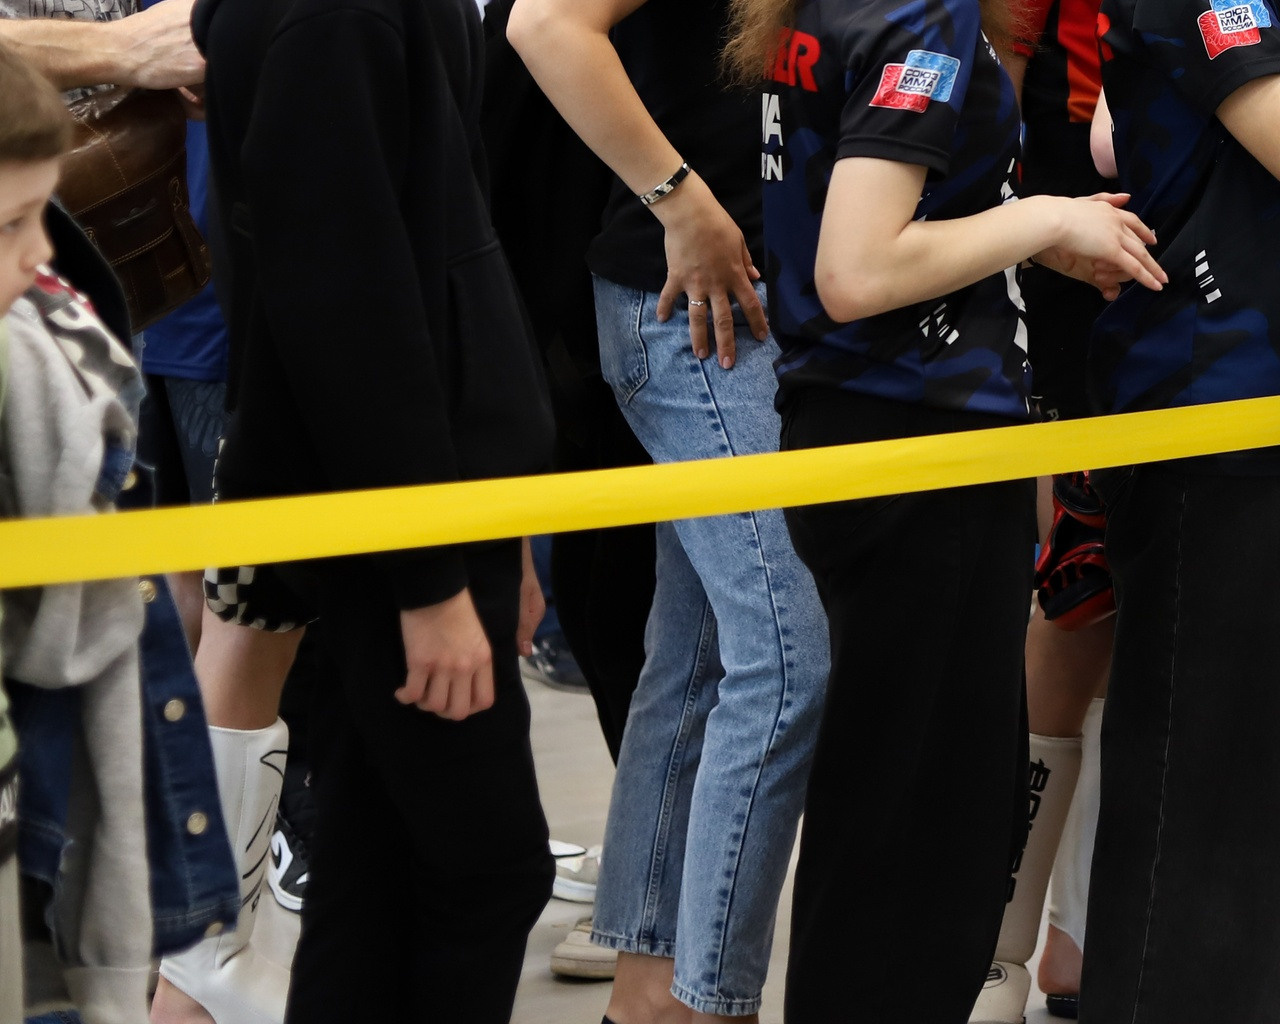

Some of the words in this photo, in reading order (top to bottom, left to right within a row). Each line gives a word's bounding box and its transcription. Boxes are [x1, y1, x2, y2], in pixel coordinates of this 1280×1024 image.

[1218, 6, 1250, 19] СОЮЗ
[1220, 13, 1252, 27] ММА
[1222, 21, 1254, 32] РОССИИ
[904, 68, 939, 81] СОЮЗ
[898, 84, 931, 94] РОССИИ
[901, 76, 934, 89] ММА
